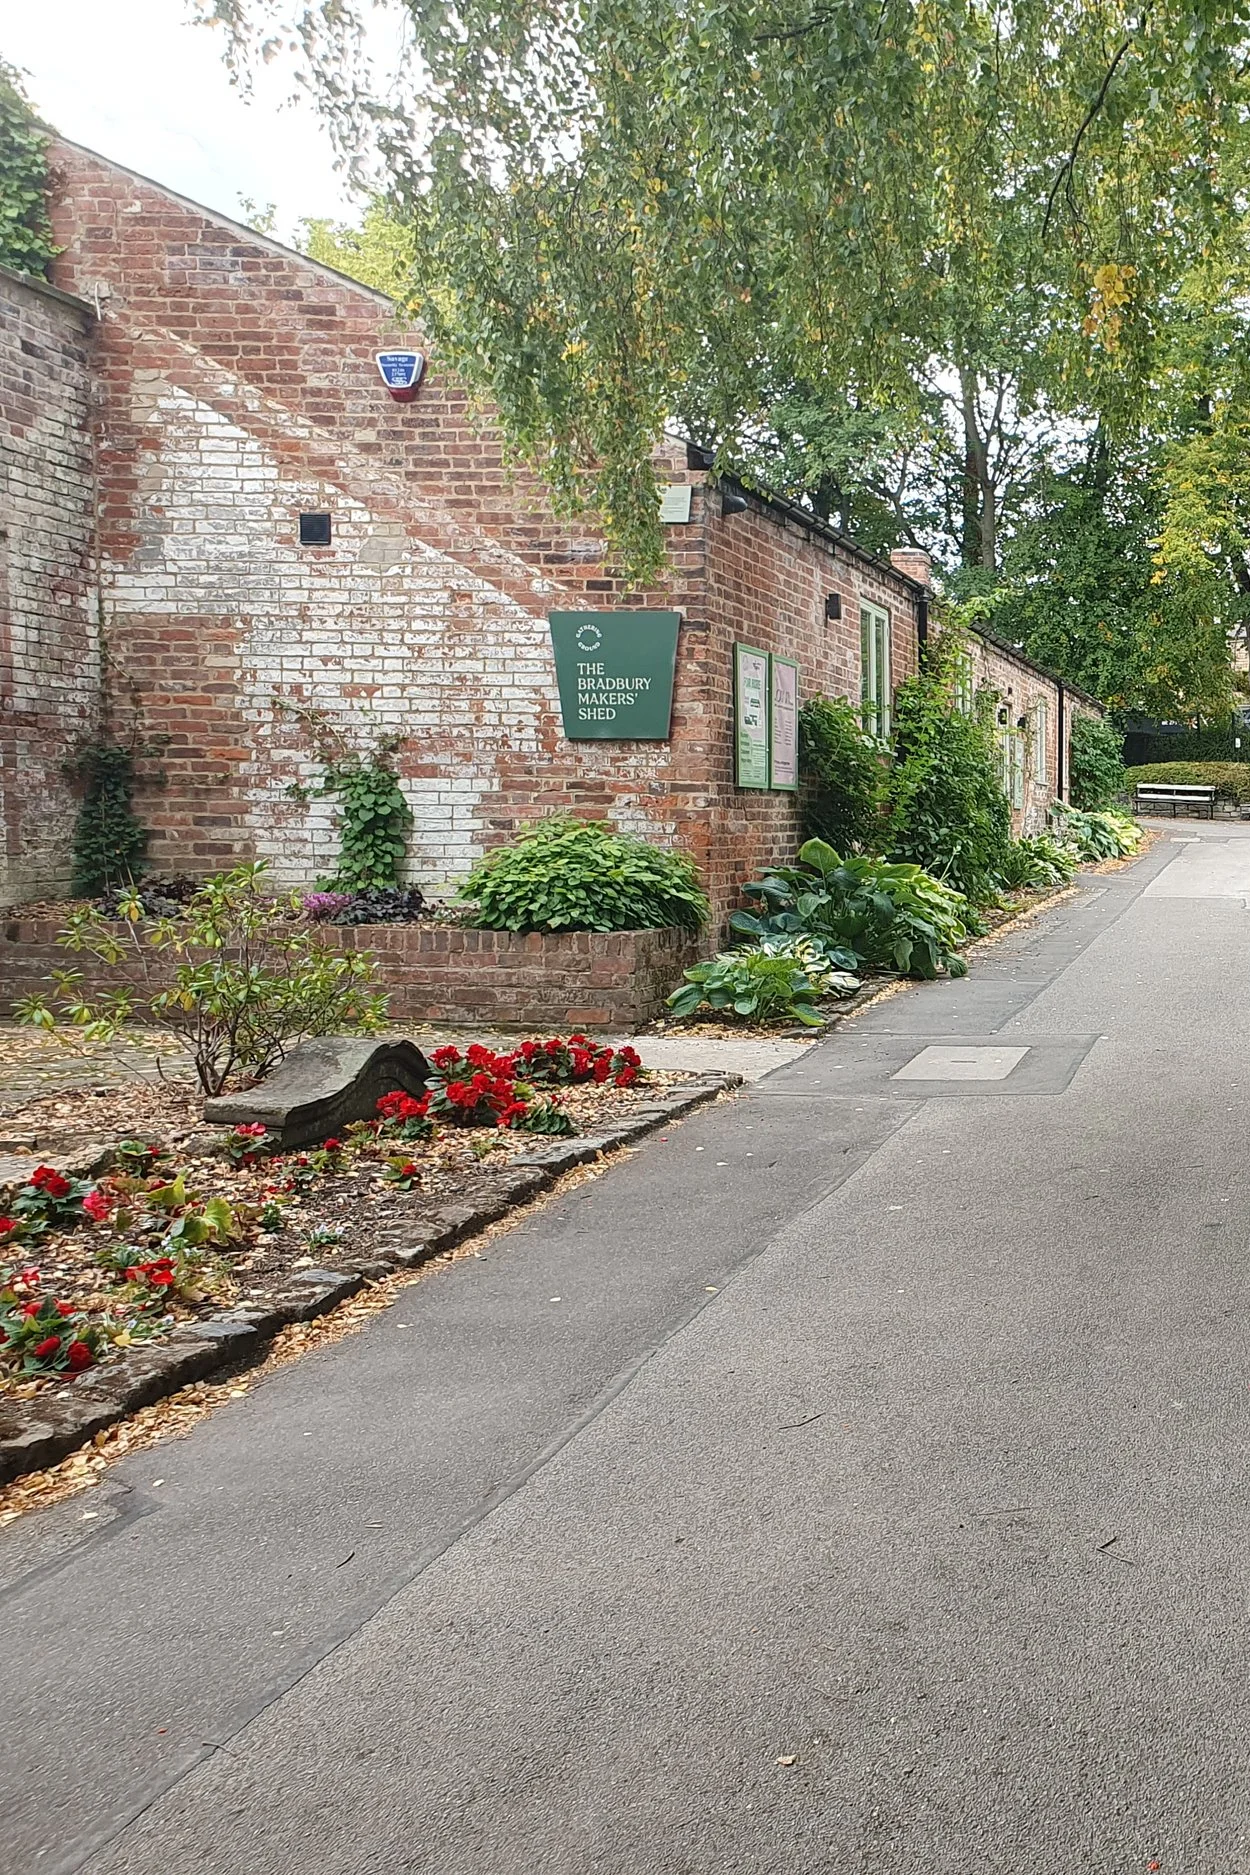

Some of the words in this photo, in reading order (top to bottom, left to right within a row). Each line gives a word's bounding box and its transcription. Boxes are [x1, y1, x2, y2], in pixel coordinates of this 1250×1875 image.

[575, 624, 603, 639] GATHERING
[577, 641, 601, 652] GROUND
[577, 662, 605, 675] THE
[577, 677, 652, 690] BRADBURY
[577, 692, 639, 705] MAKERS'
[578, 707, 616, 720] SHED
